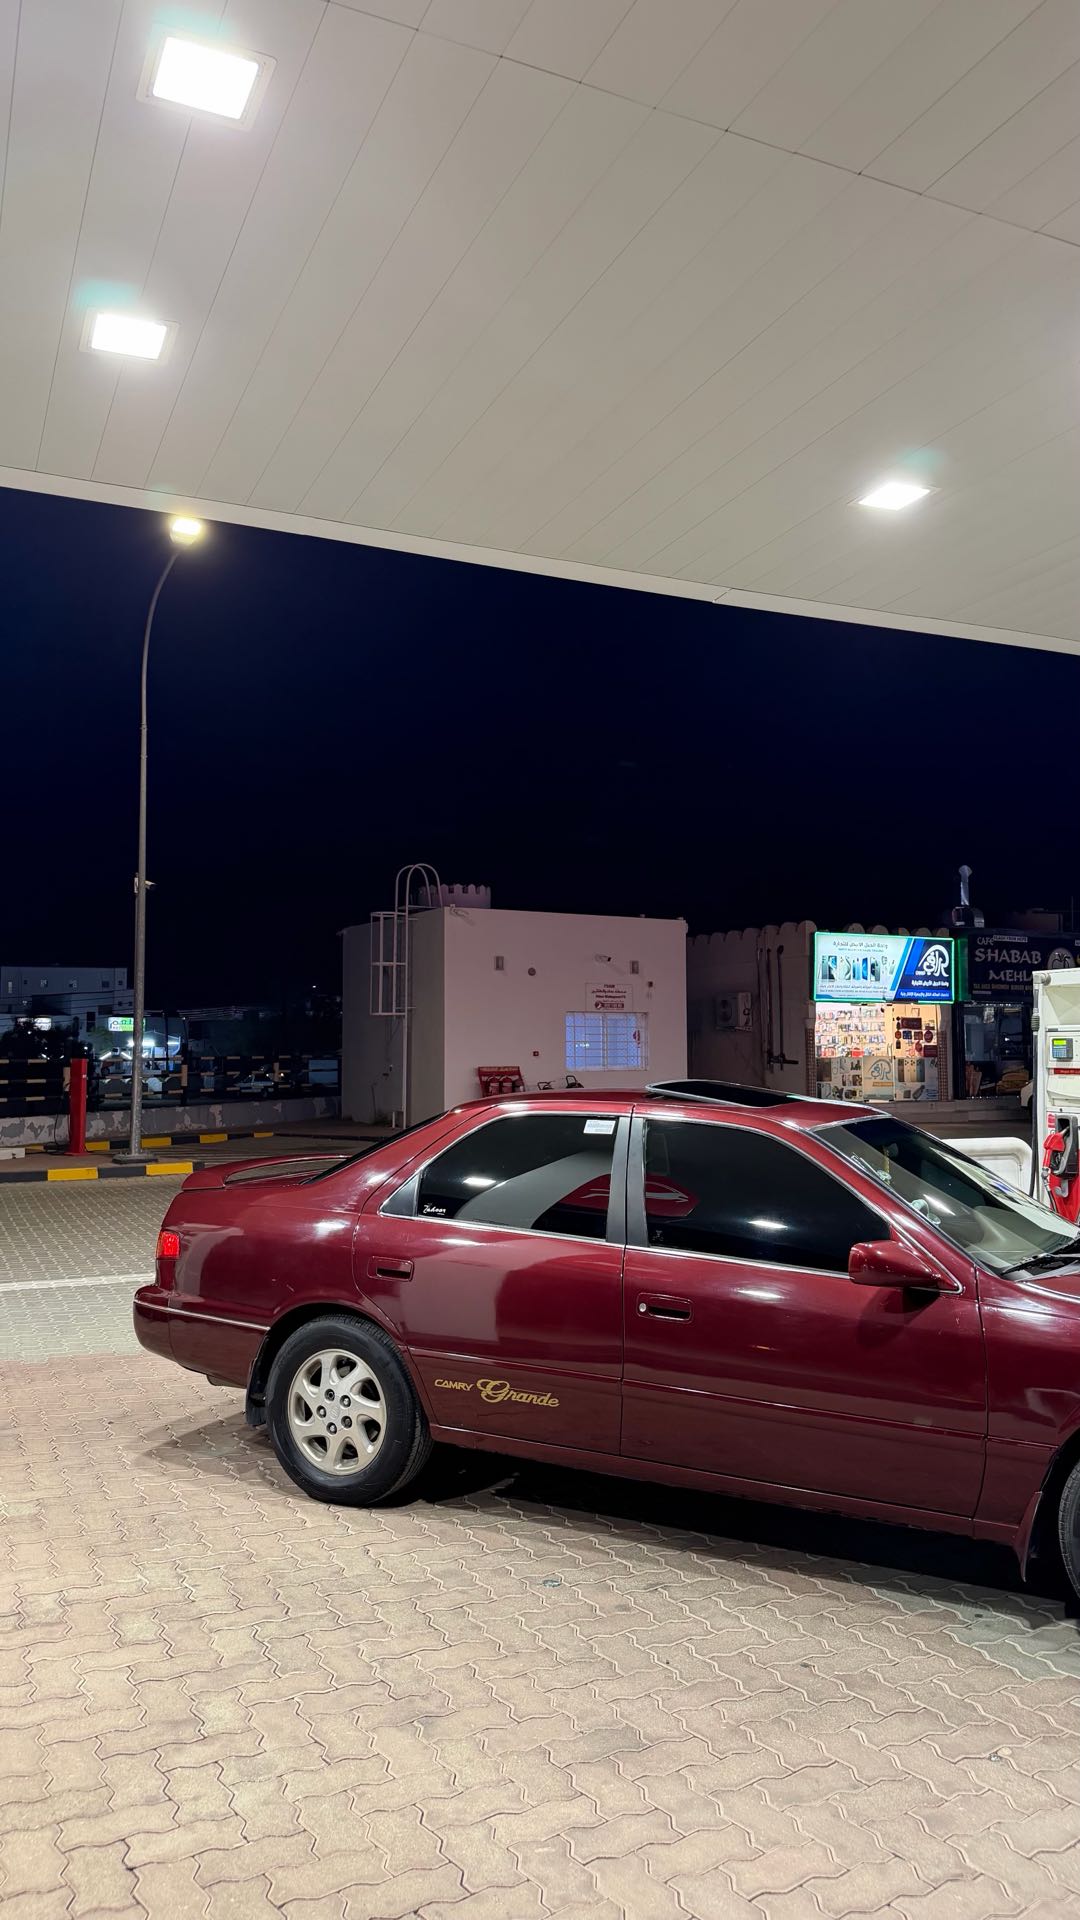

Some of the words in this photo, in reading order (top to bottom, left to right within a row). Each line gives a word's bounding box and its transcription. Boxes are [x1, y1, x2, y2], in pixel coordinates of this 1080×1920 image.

[975, 948, 1042, 965] SHABAB
[434, 1379, 474, 1392] CAMRY
[476, 1379, 560, 1407] Grande
